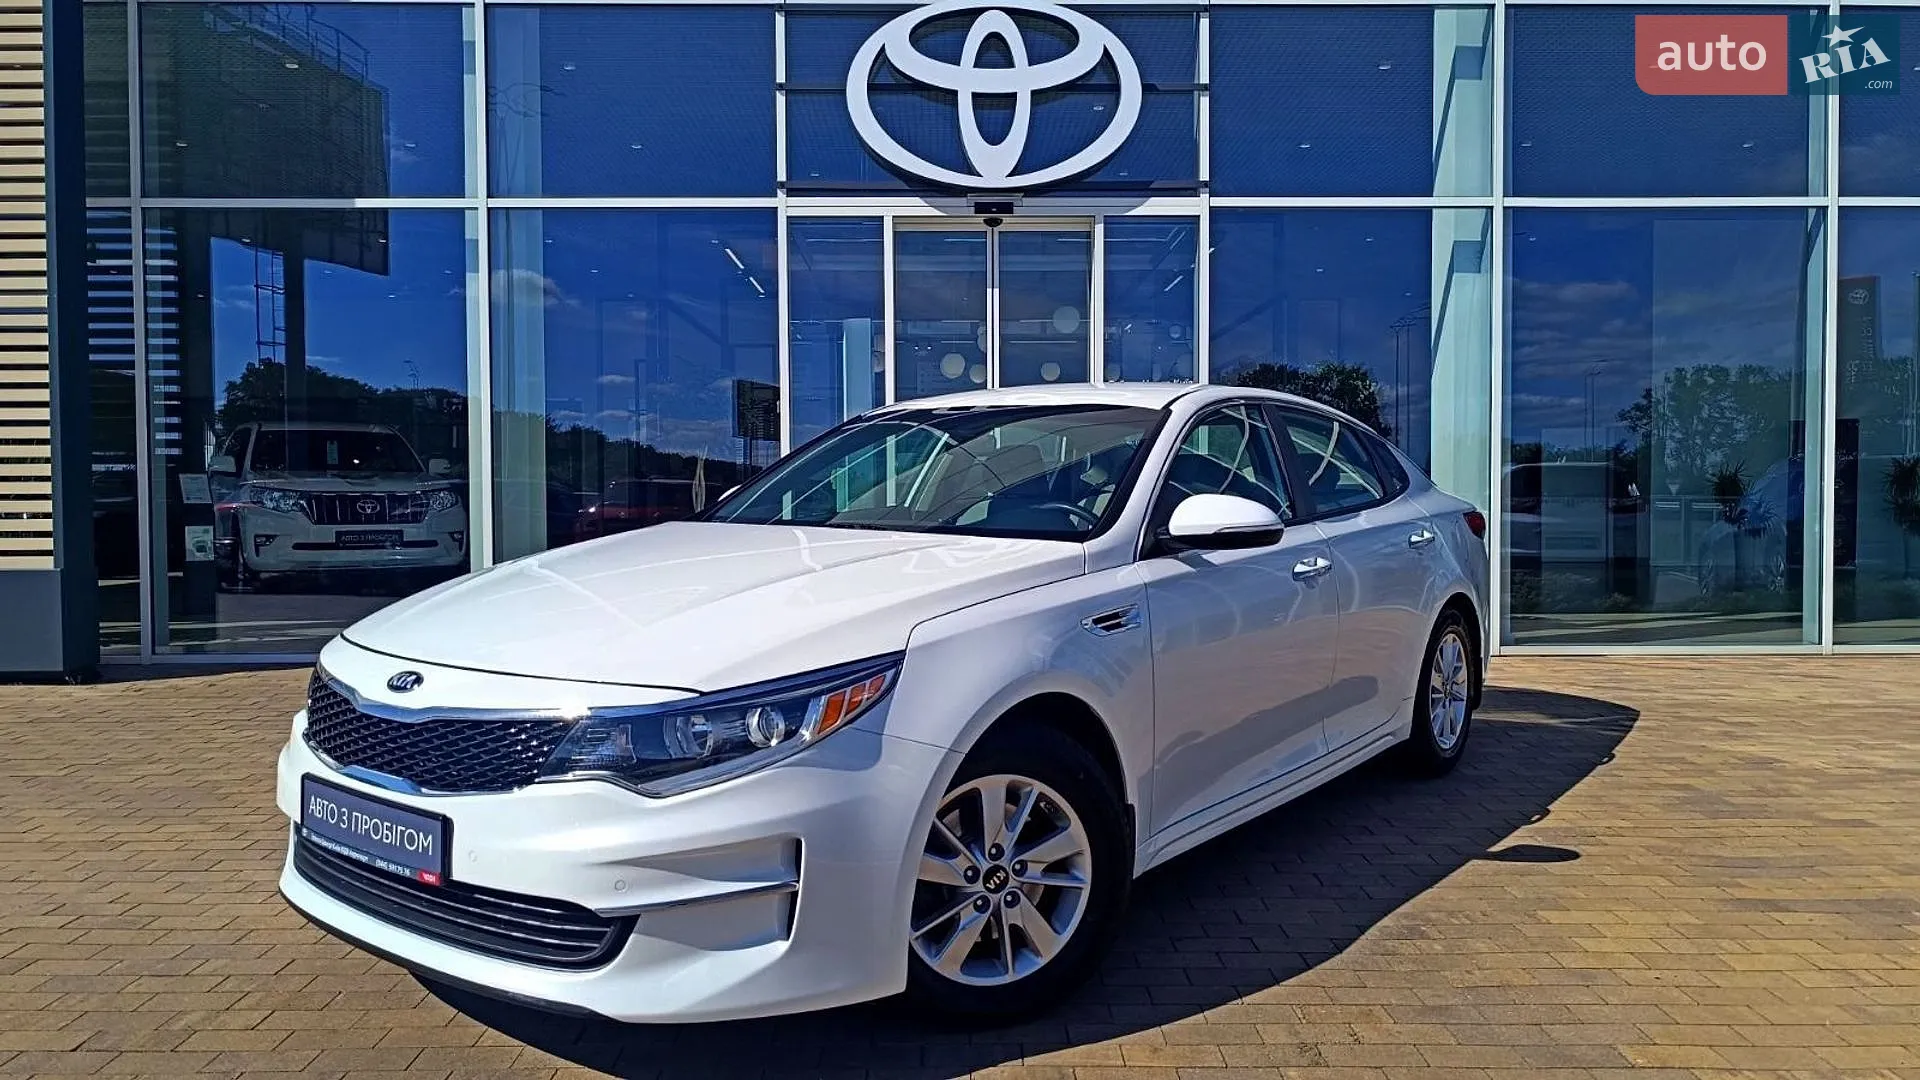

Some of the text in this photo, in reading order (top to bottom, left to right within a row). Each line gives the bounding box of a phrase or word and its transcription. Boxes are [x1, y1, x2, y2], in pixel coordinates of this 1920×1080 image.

[309, 794, 338, 824] АВТО
[340, 808, 348, 828] З
[352, 812, 432, 856] ПРОБІГОМ
[986, 869, 1007, 889] KIA
